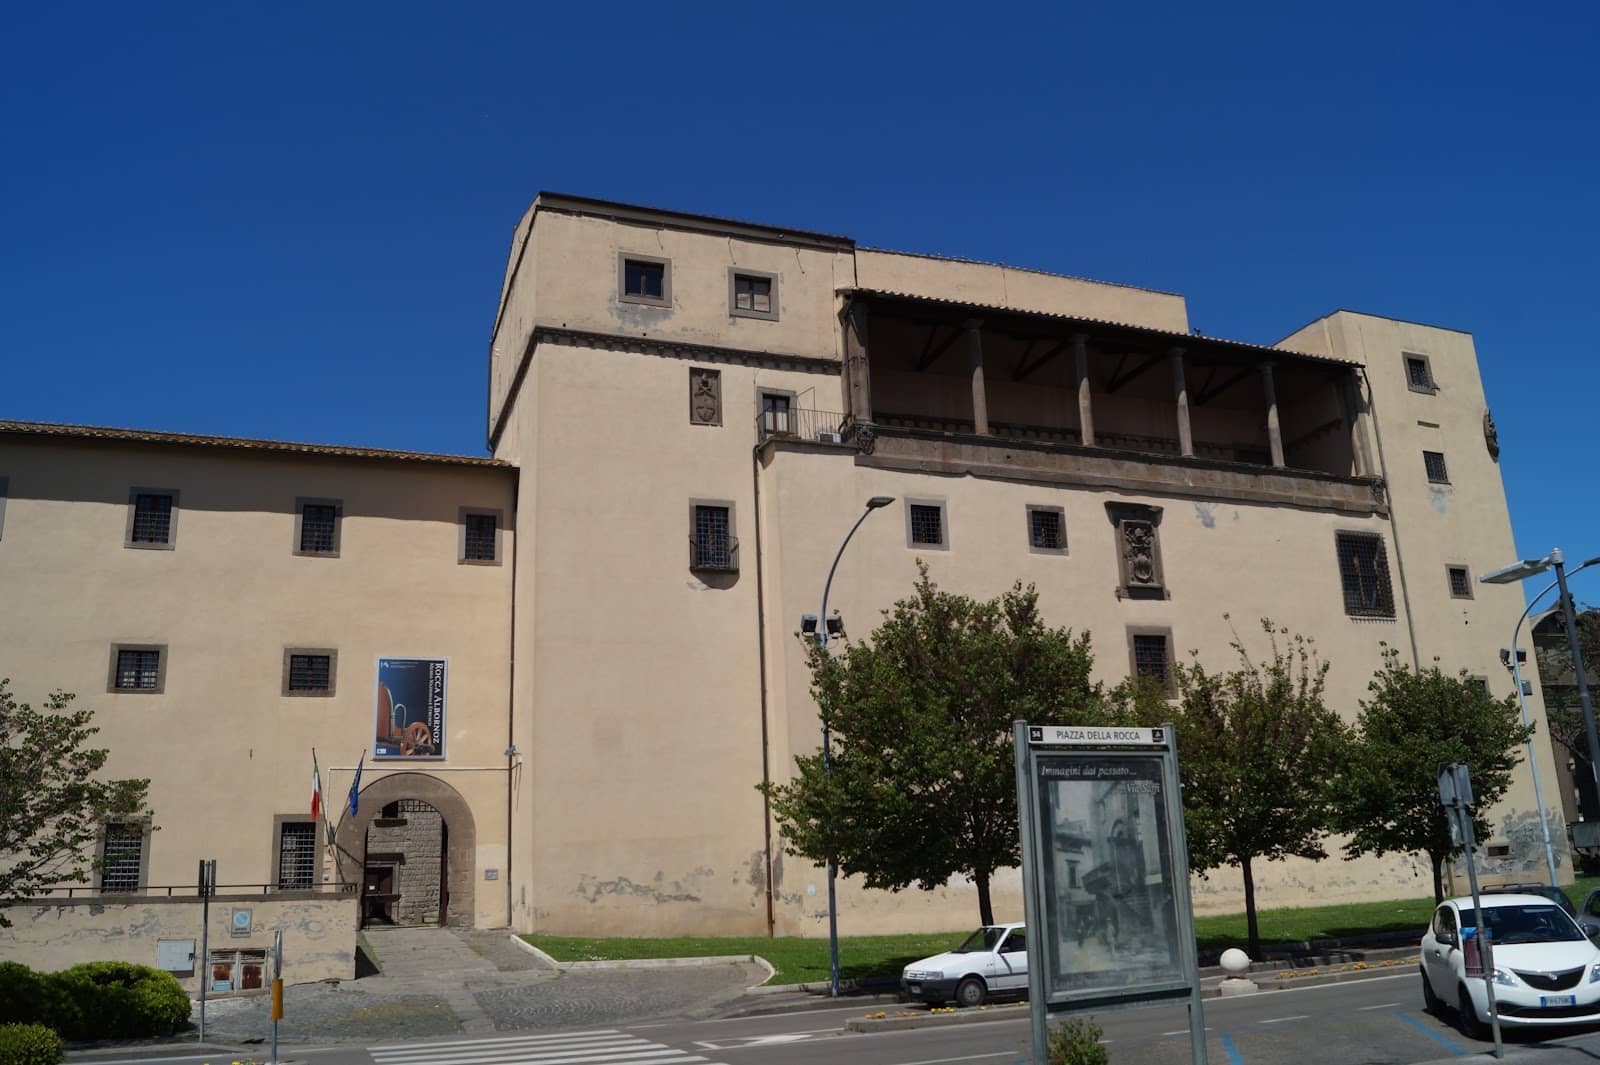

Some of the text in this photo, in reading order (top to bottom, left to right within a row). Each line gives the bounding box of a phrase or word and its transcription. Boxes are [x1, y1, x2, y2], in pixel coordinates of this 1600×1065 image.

[1056, 730, 1140, 741] PIAZZA DELLA ROCCA
[1041, 765, 1081, 777] Immagini
